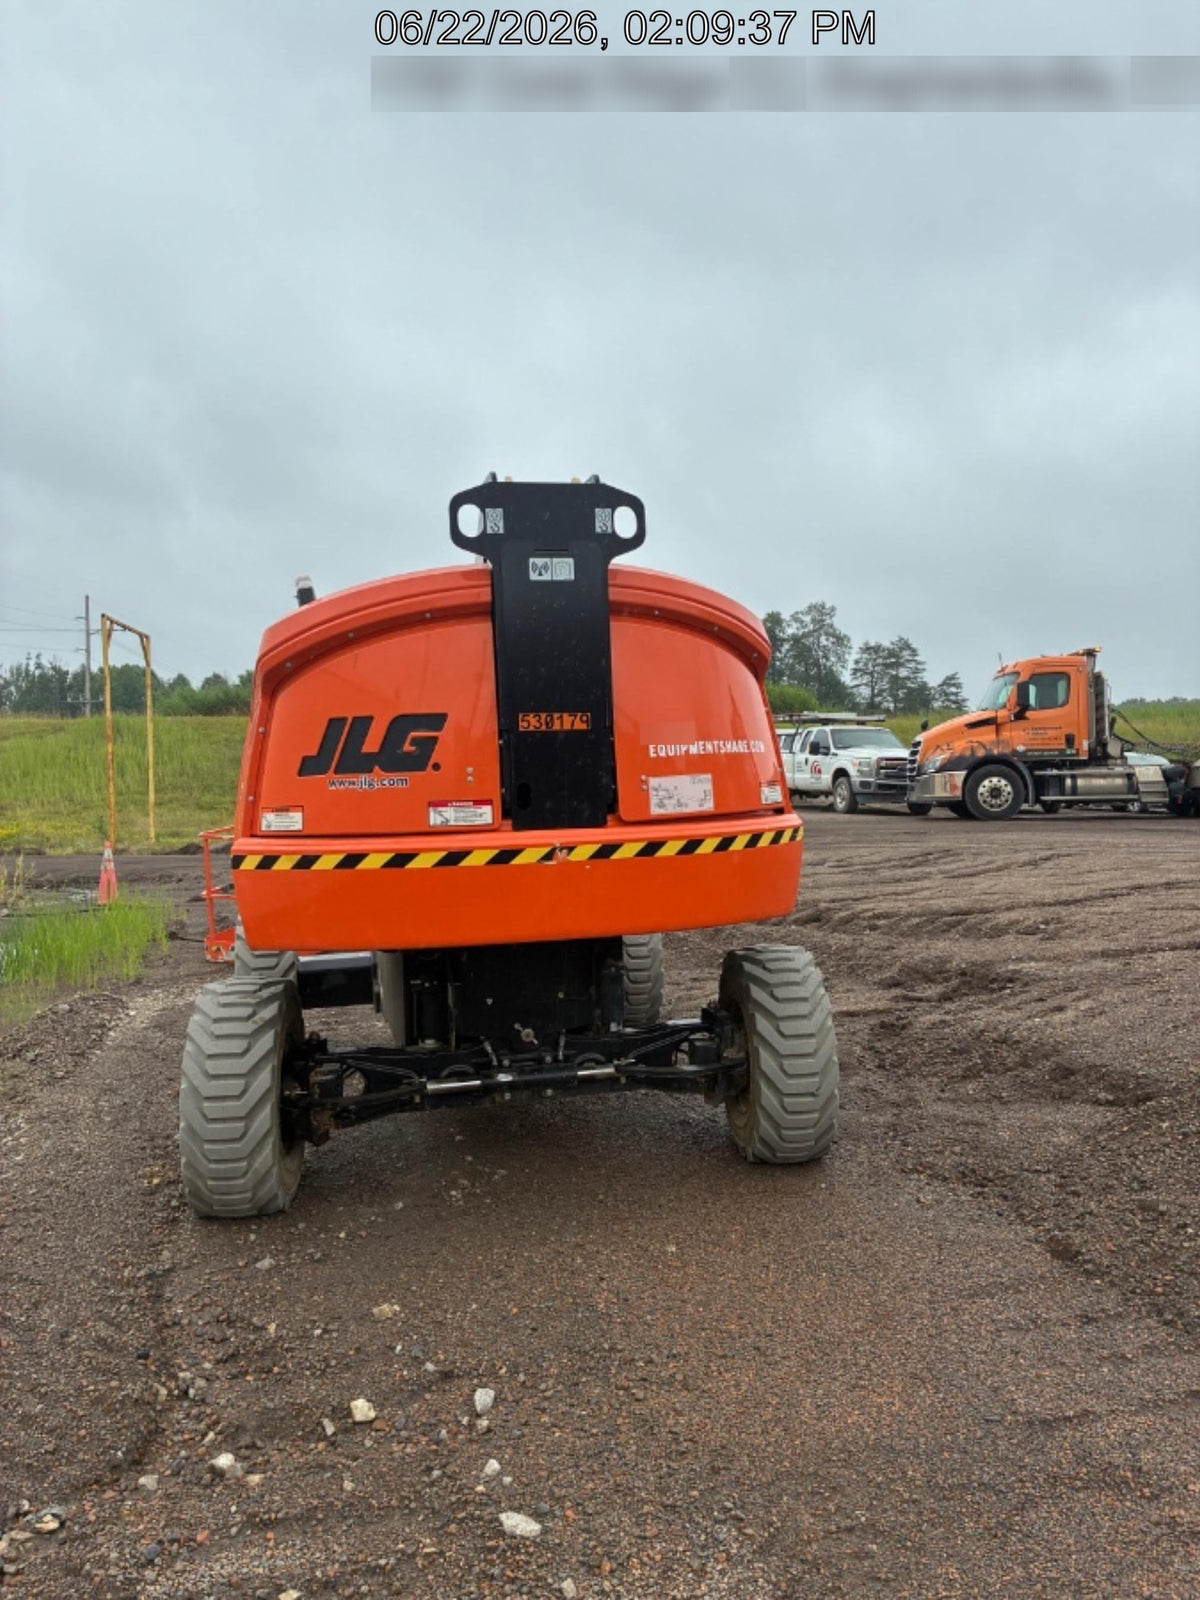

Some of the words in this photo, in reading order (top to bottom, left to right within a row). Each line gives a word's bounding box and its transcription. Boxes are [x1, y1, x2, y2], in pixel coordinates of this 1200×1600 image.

[520, 713, 589, 730] 530179
[297, 712, 448, 777] JLG
[328, 775, 409, 790] www.jlg.com
